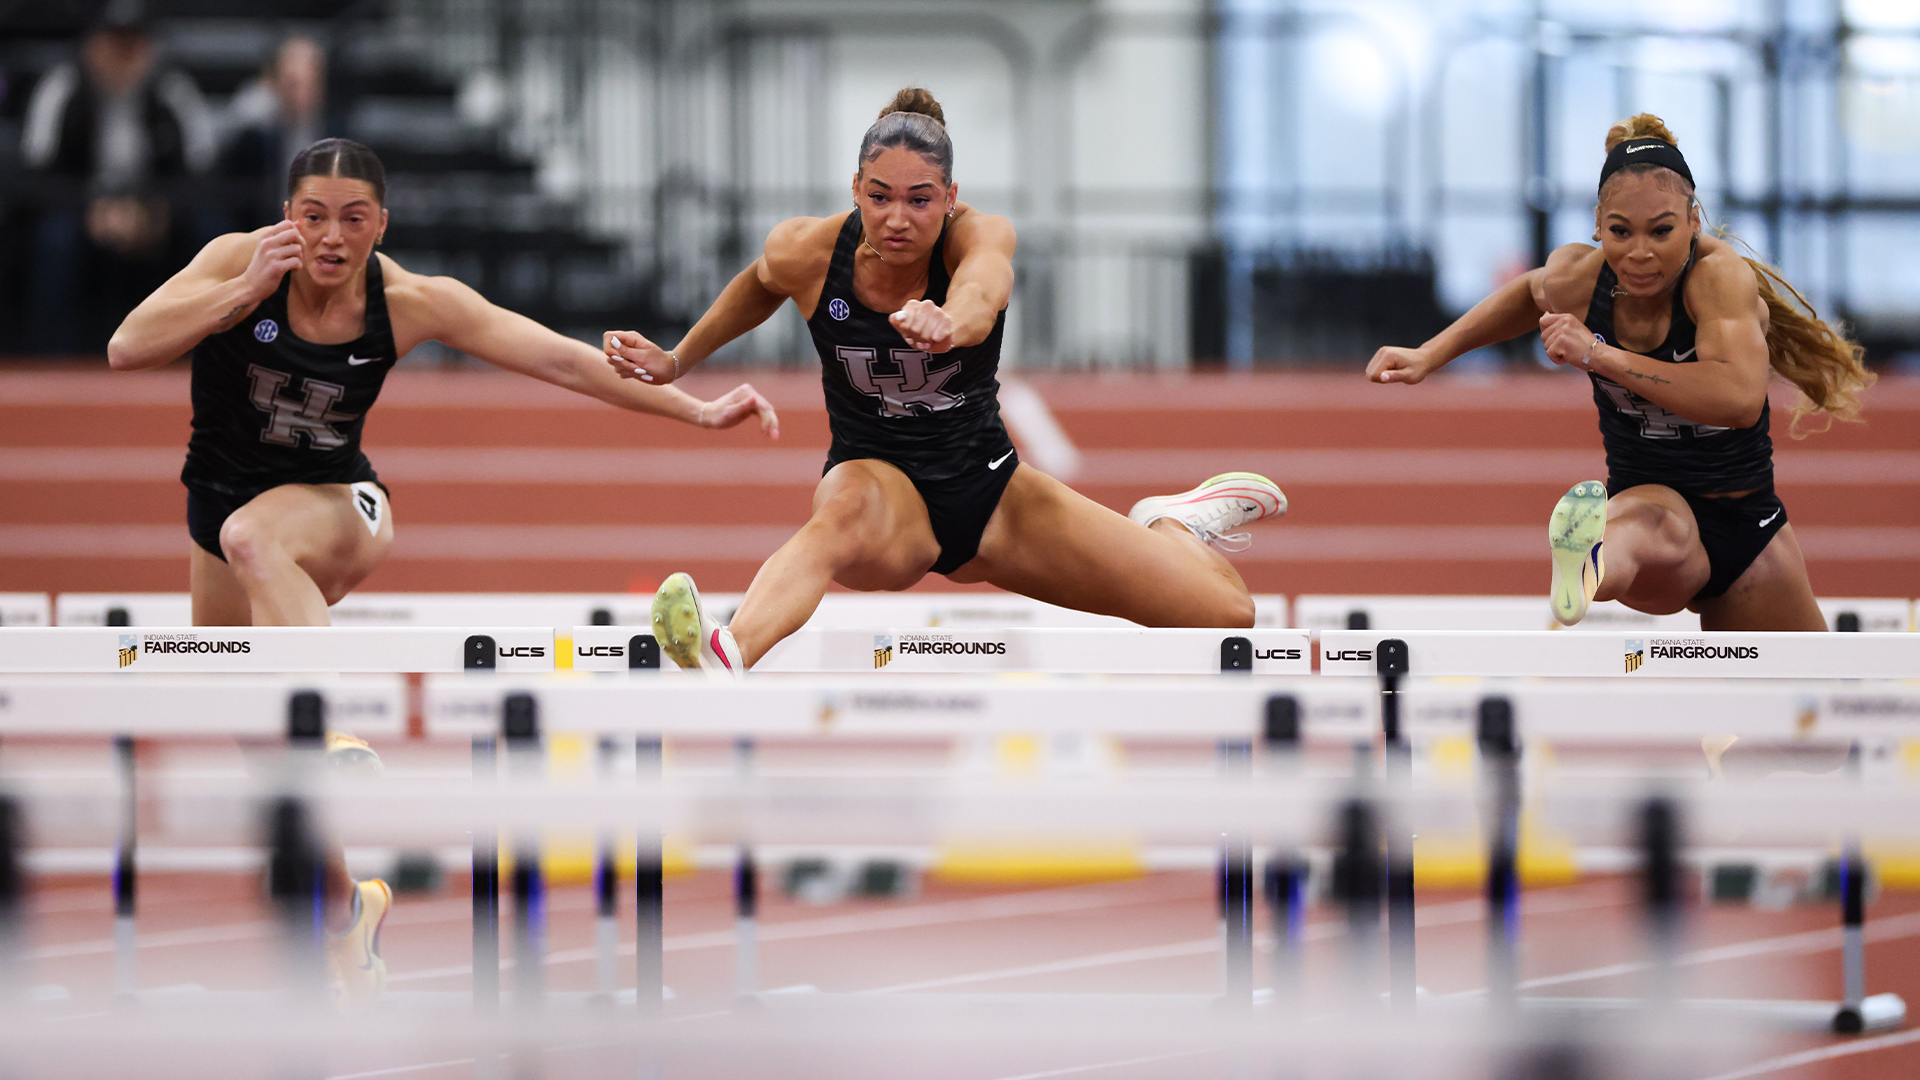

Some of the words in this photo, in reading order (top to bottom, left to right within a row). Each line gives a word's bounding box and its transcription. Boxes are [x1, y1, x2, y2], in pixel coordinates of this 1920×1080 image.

[829, 298, 850, 321] SEC
[254, 319, 279, 343] SEC
[835, 345, 966, 419] UK
[246, 363, 361, 451] UK
[144, 641, 251, 654] FAIRGROUNDS
[499, 646, 545, 658] UCS
[578, 646, 624, 657] UCS
[899, 642, 1006, 655] FAIRGROUNDS
[1650, 646, 1759, 659] FAIRGROUNDS
[1255, 649, 1302, 660] UCS
[1326, 650, 1372, 661] UCS
